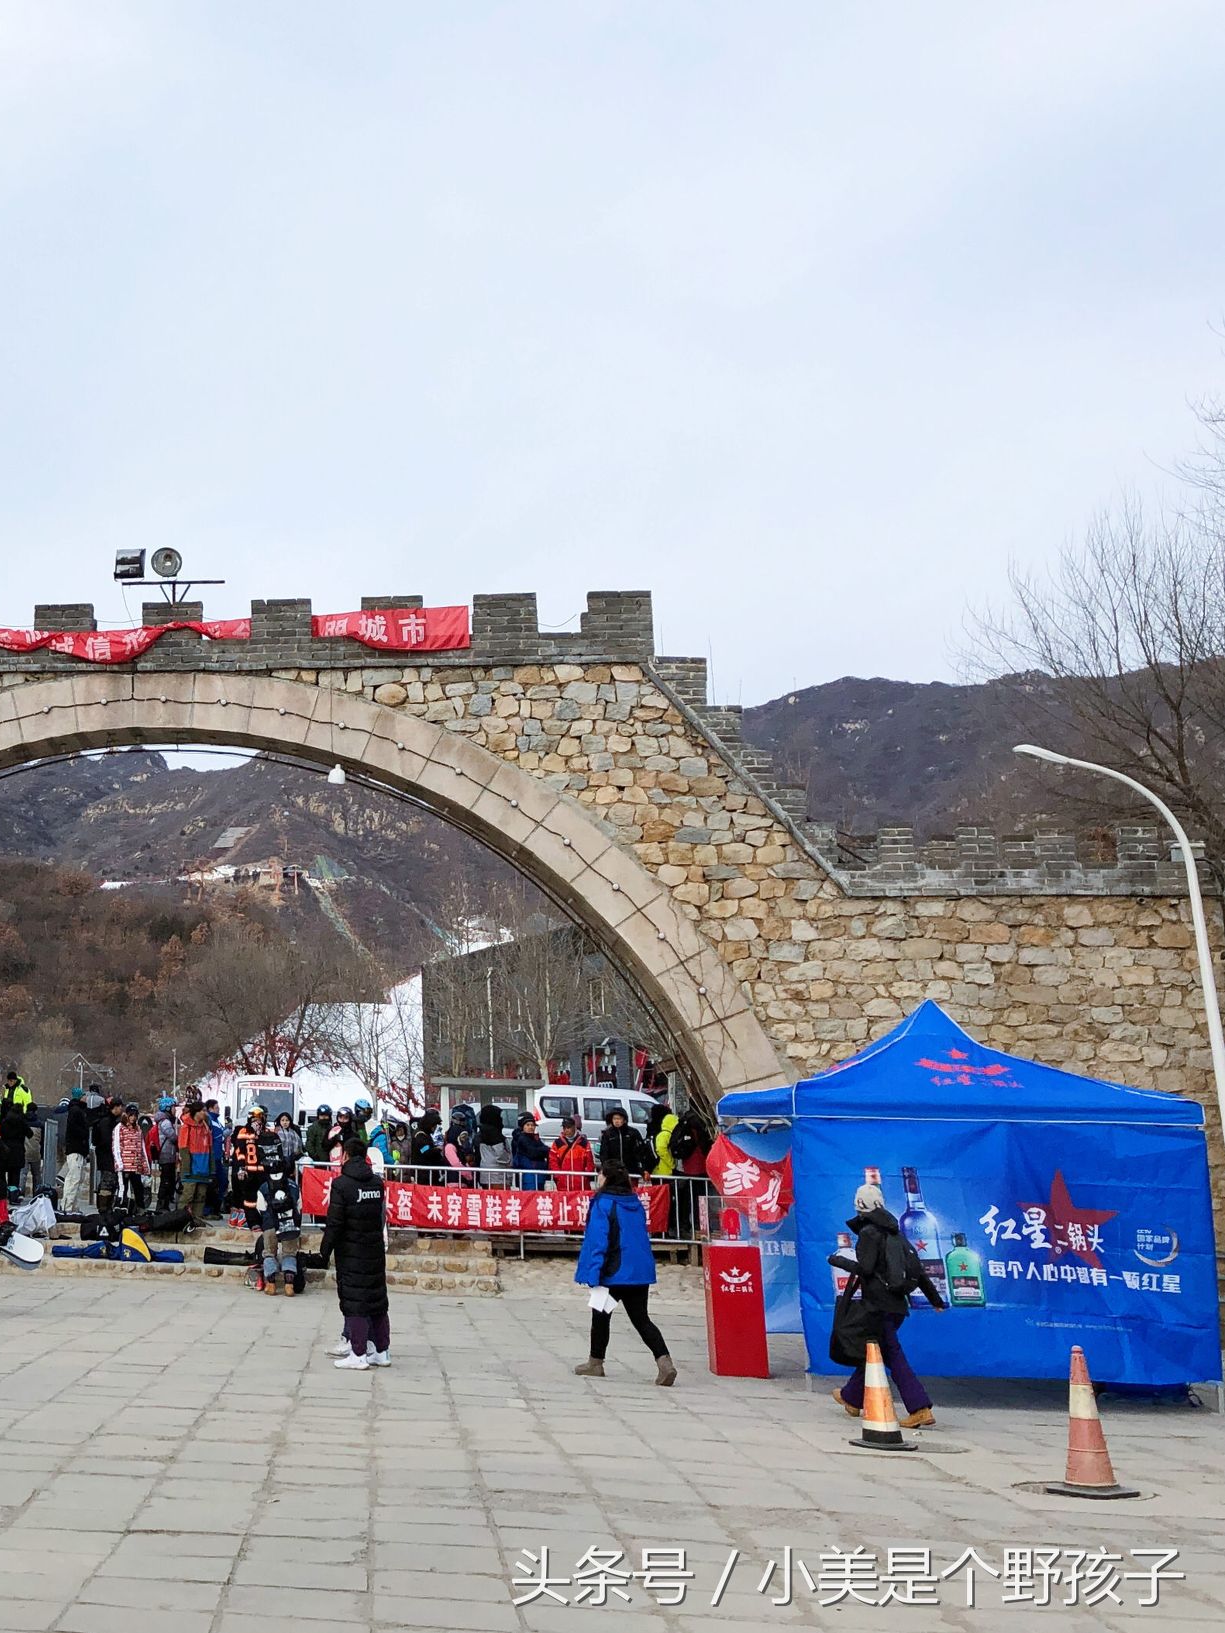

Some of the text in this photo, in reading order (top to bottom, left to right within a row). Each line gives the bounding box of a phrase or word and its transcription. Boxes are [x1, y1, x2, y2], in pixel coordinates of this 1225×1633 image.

[356, 1188, 381, 1203] Joma
[427, 1192, 522, 1227] 未穿雪鞋者
[979, 1204, 1105, 1253] 红星二锅头
[988, 1259, 1182, 1294] 每个人心中都有一颗红星
